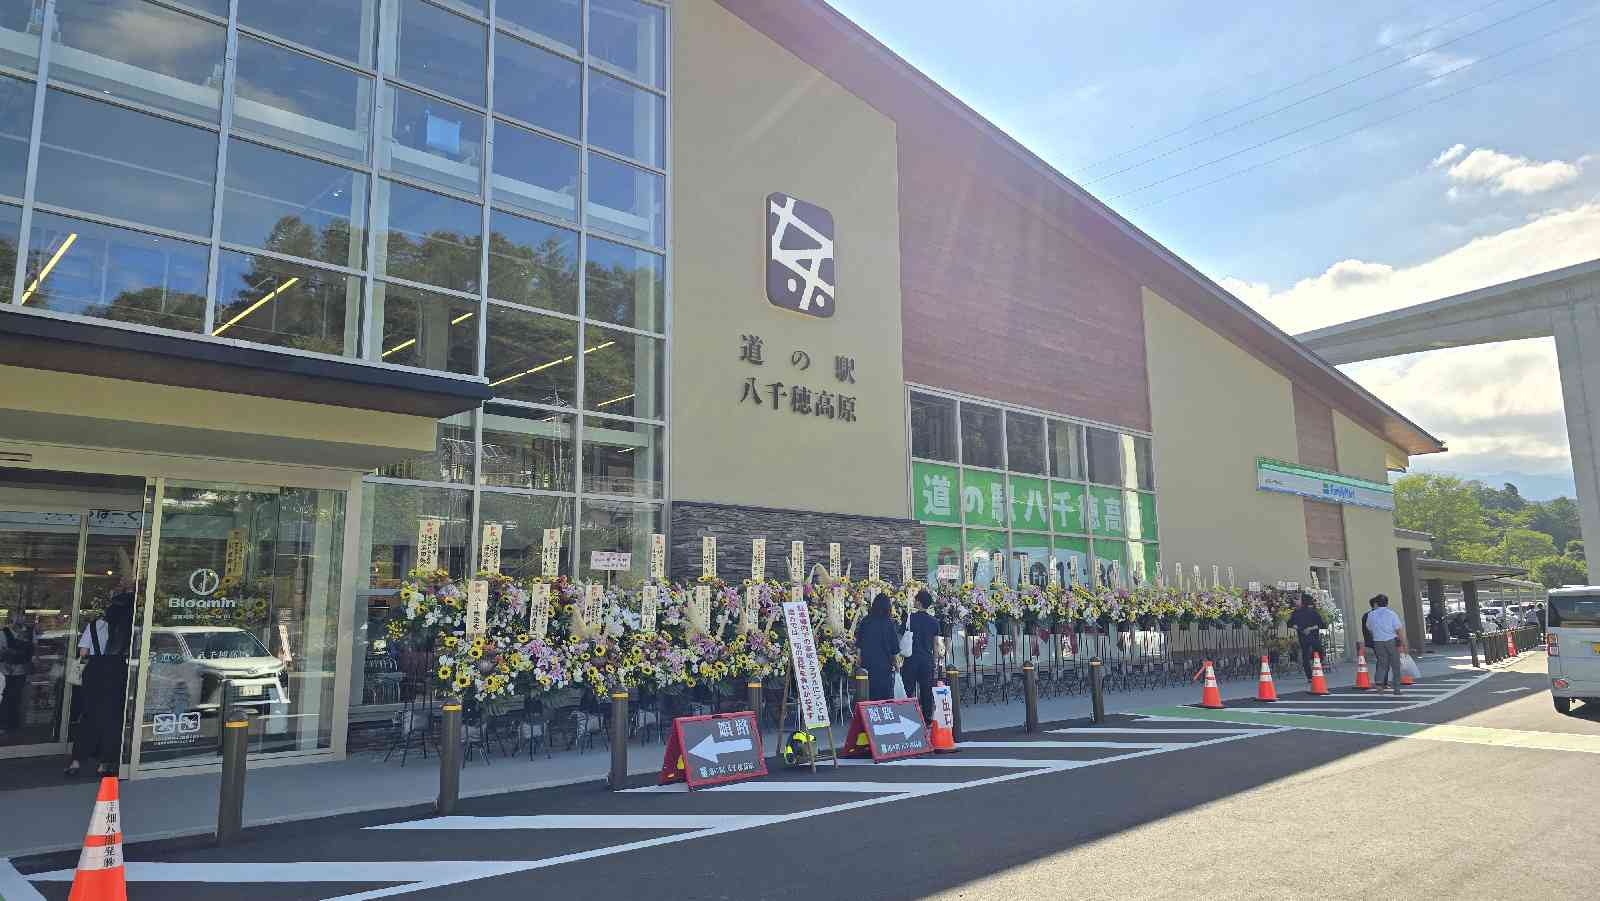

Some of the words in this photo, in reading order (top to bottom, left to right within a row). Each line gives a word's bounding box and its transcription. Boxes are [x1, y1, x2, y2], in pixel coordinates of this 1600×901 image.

[739, 334, 855, 384] 道の駅
[740, 377, 857, 422] 八千穂高原
[922, 474, 1122, 532] 道の駅八千穂高
[168, 597, 236, 608] Bloomin
